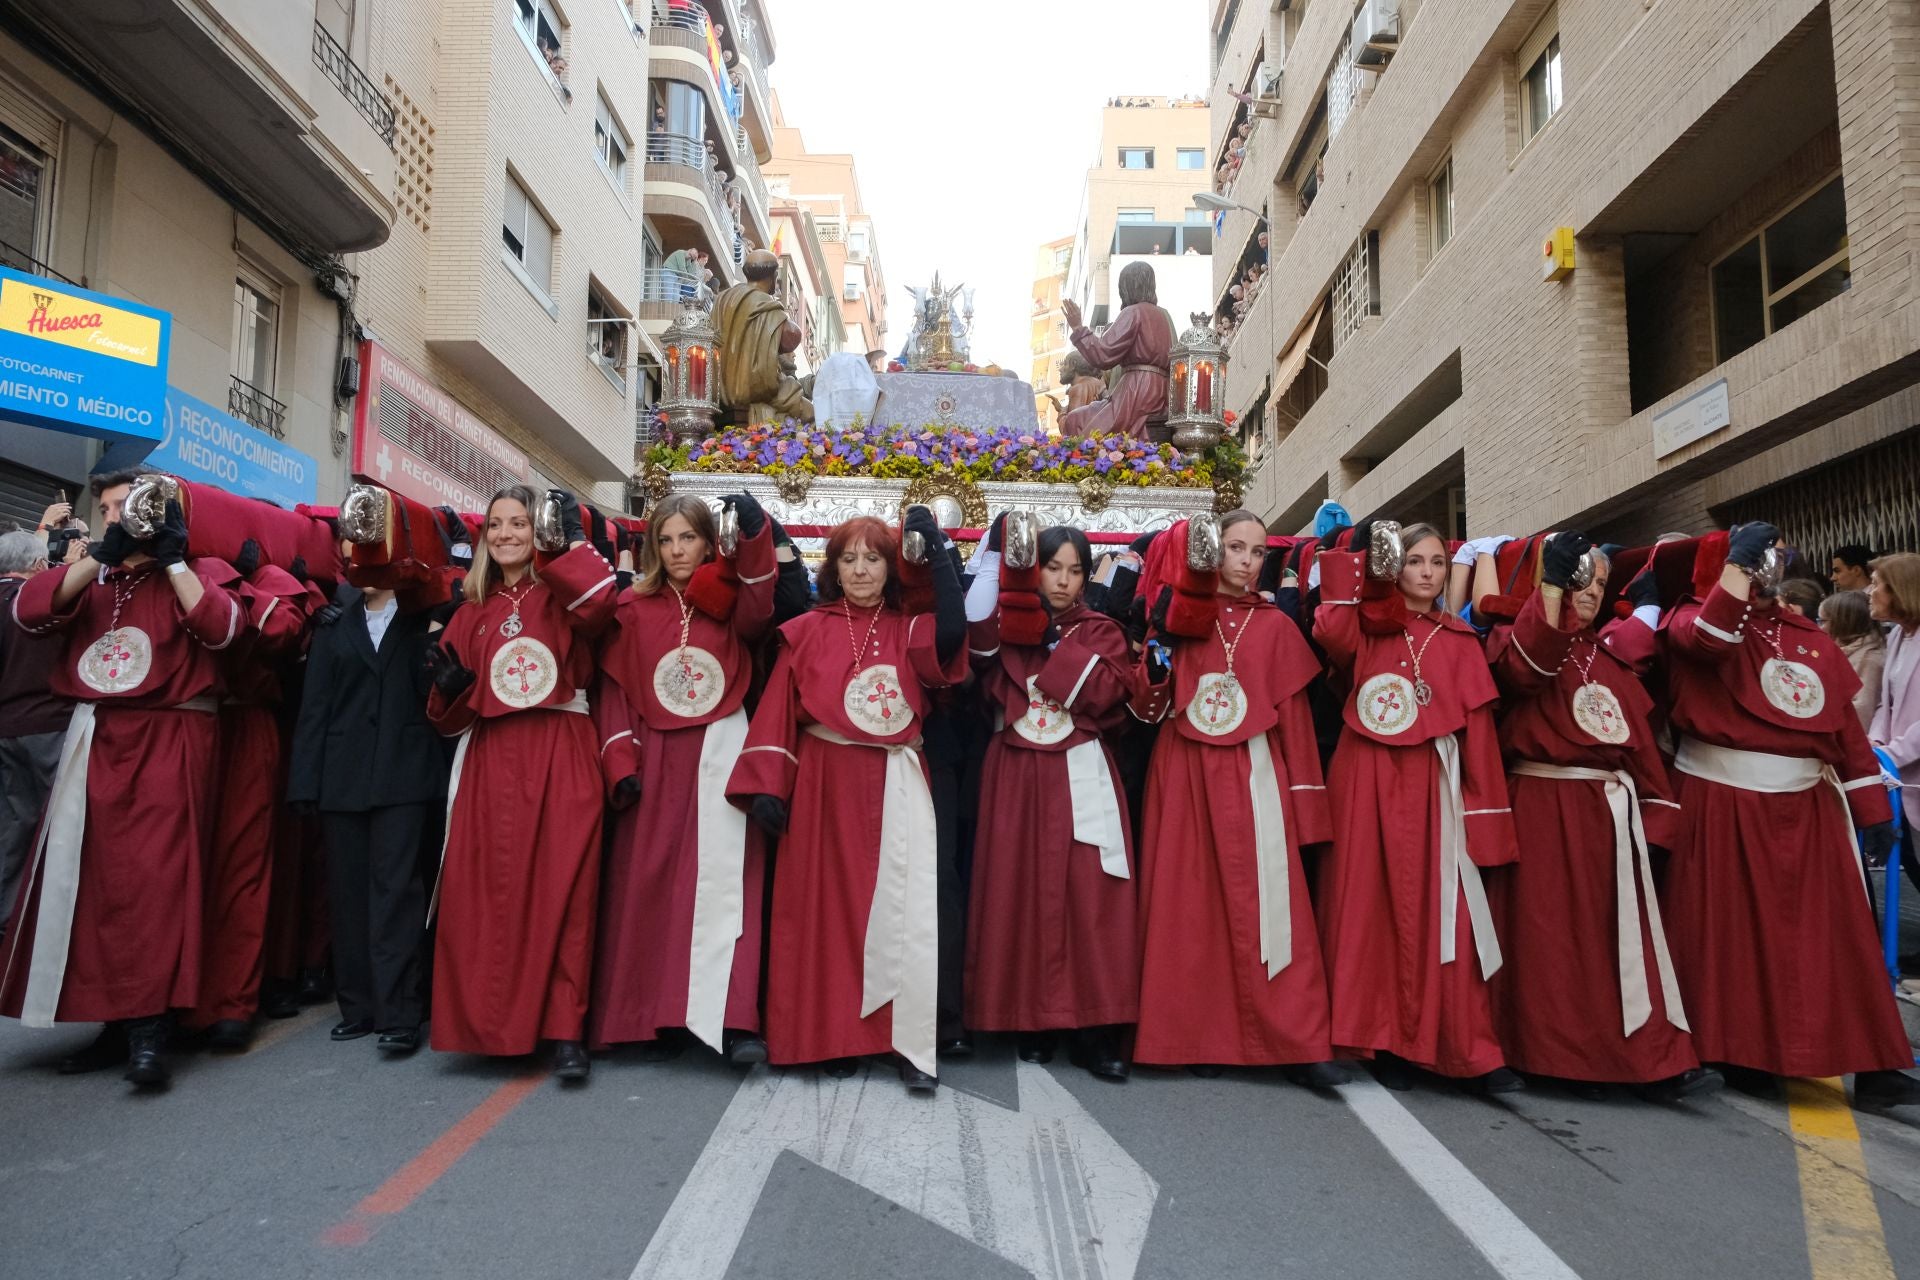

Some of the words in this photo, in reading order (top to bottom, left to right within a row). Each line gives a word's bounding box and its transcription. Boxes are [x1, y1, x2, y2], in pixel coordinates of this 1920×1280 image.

[27, 307, 103, 334] Huesca
[77, 396, 152, 426] MÉDICO
[178, 436, 239, 483] MÉDICO
[180, 406, 304, 484] RECONOCIMIENTO
[438, 398, 452, 423] DEL
[455, 411, 482, 445] CARNET
[483, 432, 493, 452] DE
[492, 440, 524, 474] CONDUCIR
